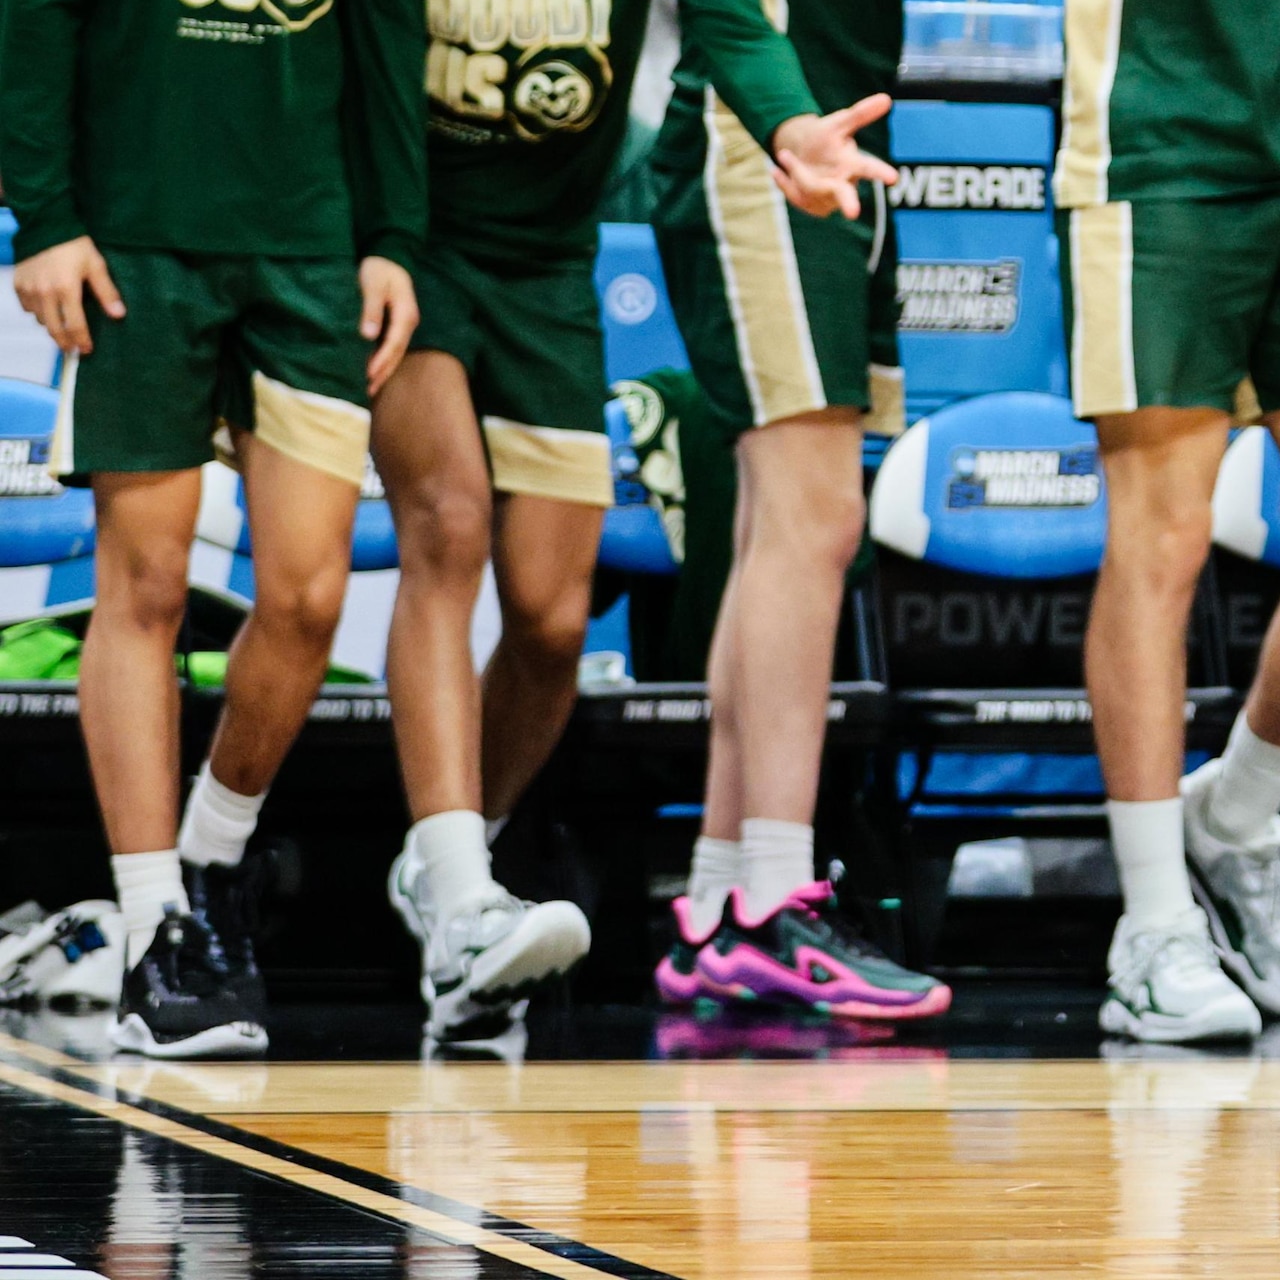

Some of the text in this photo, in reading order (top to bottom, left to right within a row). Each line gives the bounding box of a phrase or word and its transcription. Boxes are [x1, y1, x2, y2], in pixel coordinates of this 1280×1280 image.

[424, 39, 508, 119] US
[889, 166, 1045, 209] WERADE
[976, 451, 1060, 478] MARCH
[985, 473, 1099, 506] MADNESS
[894, 590, 1261, 646] POWEE
